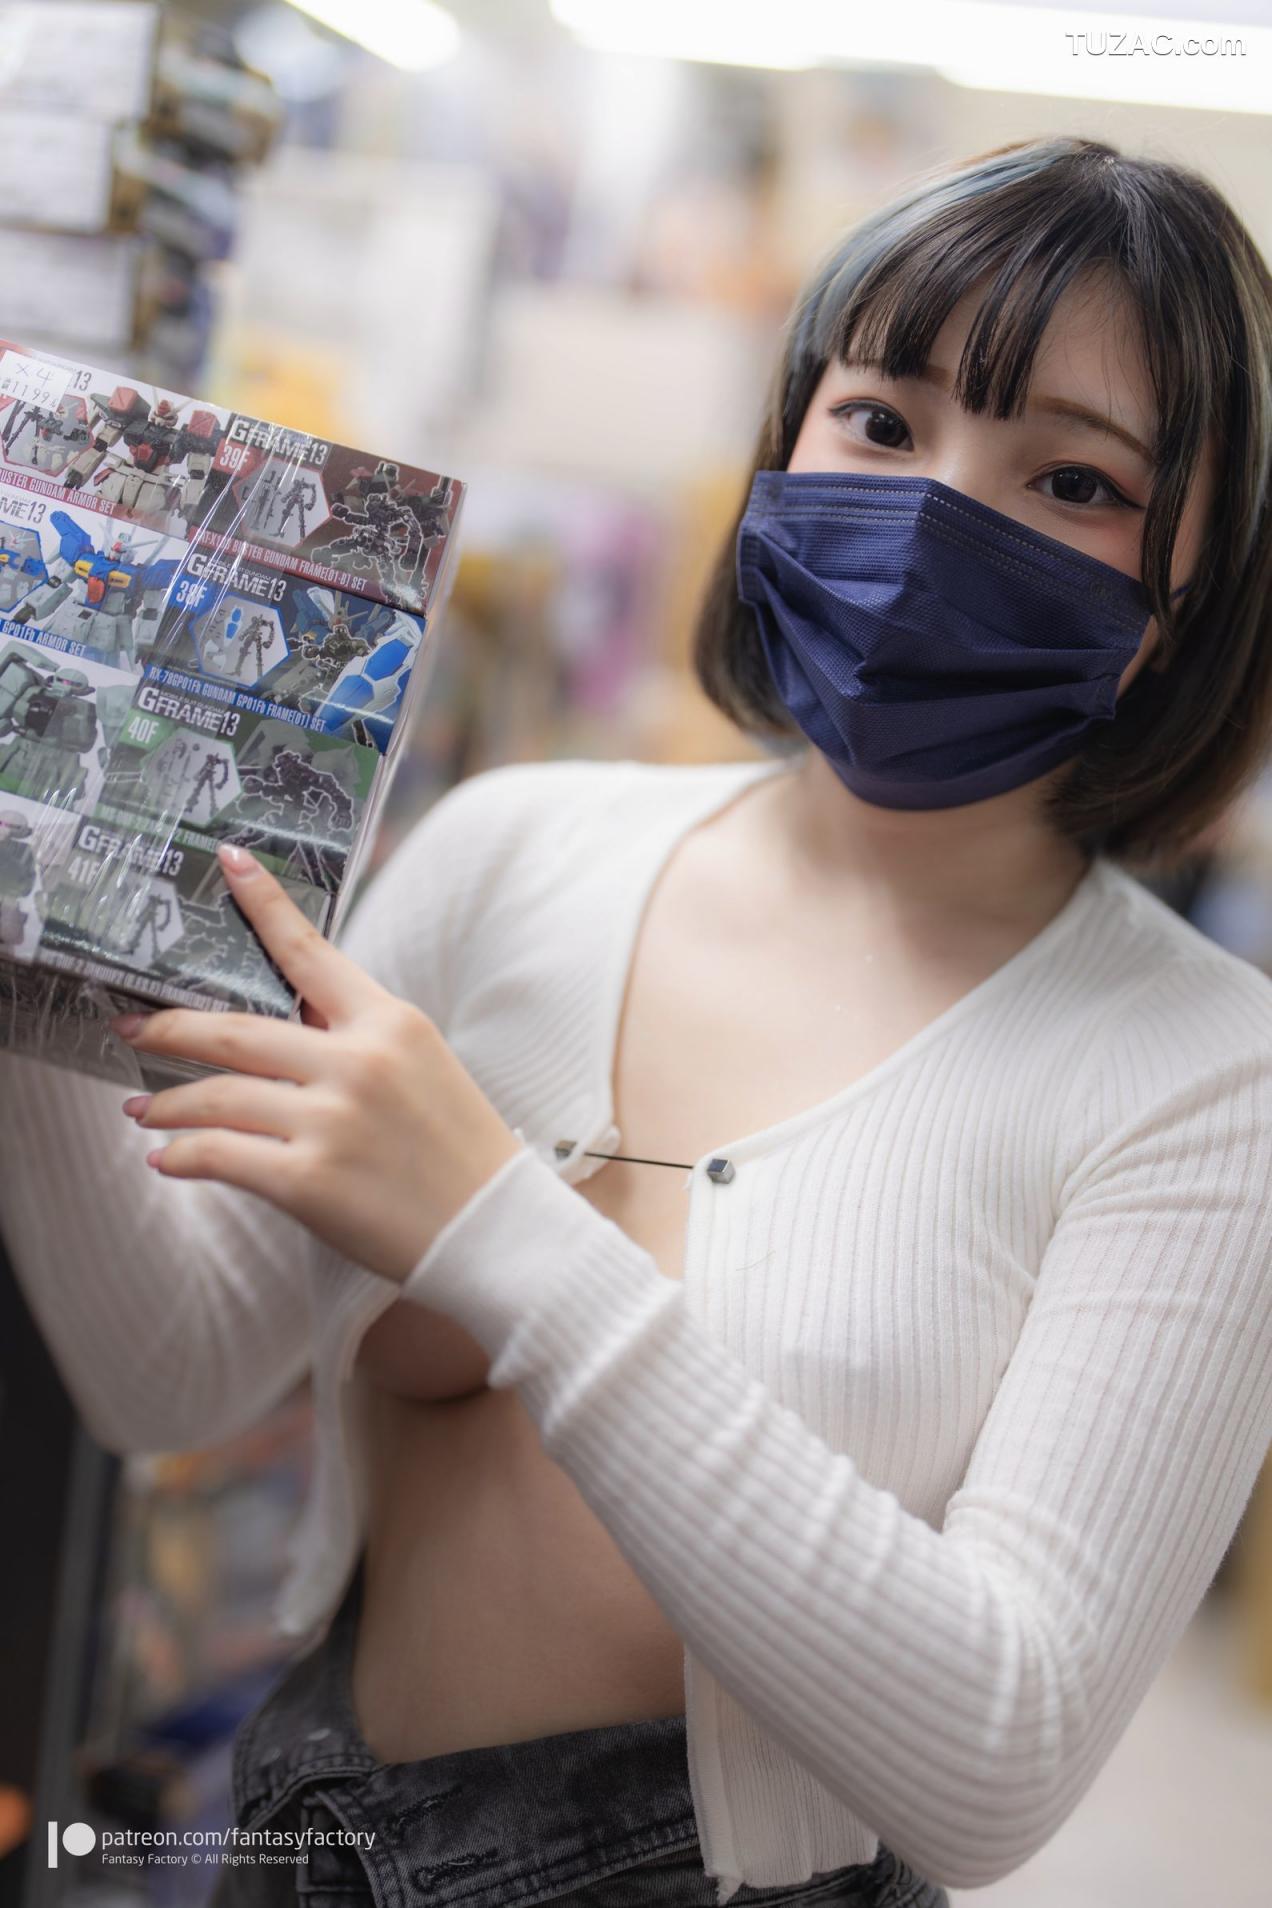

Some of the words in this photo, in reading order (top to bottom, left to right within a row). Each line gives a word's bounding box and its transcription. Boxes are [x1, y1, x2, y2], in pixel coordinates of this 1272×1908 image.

[29, 476, 66, 501] GUNDAM
[66, 488, 98, 512] ARMOR
[98, 499, 117, 515] SET
[264, 549, 298, 570] GUNDAM
[351, 576, 368, 592] SET
[35, 631, 68, 654] ARMOR
[68, 641, 87, 657] SET
[138, 686, 240, 737] GFRAME13
[201, 683, 236, 704] GUNDAM
[309, 717, 327, 733] SET
[128, 716, 160, 744] 40F
